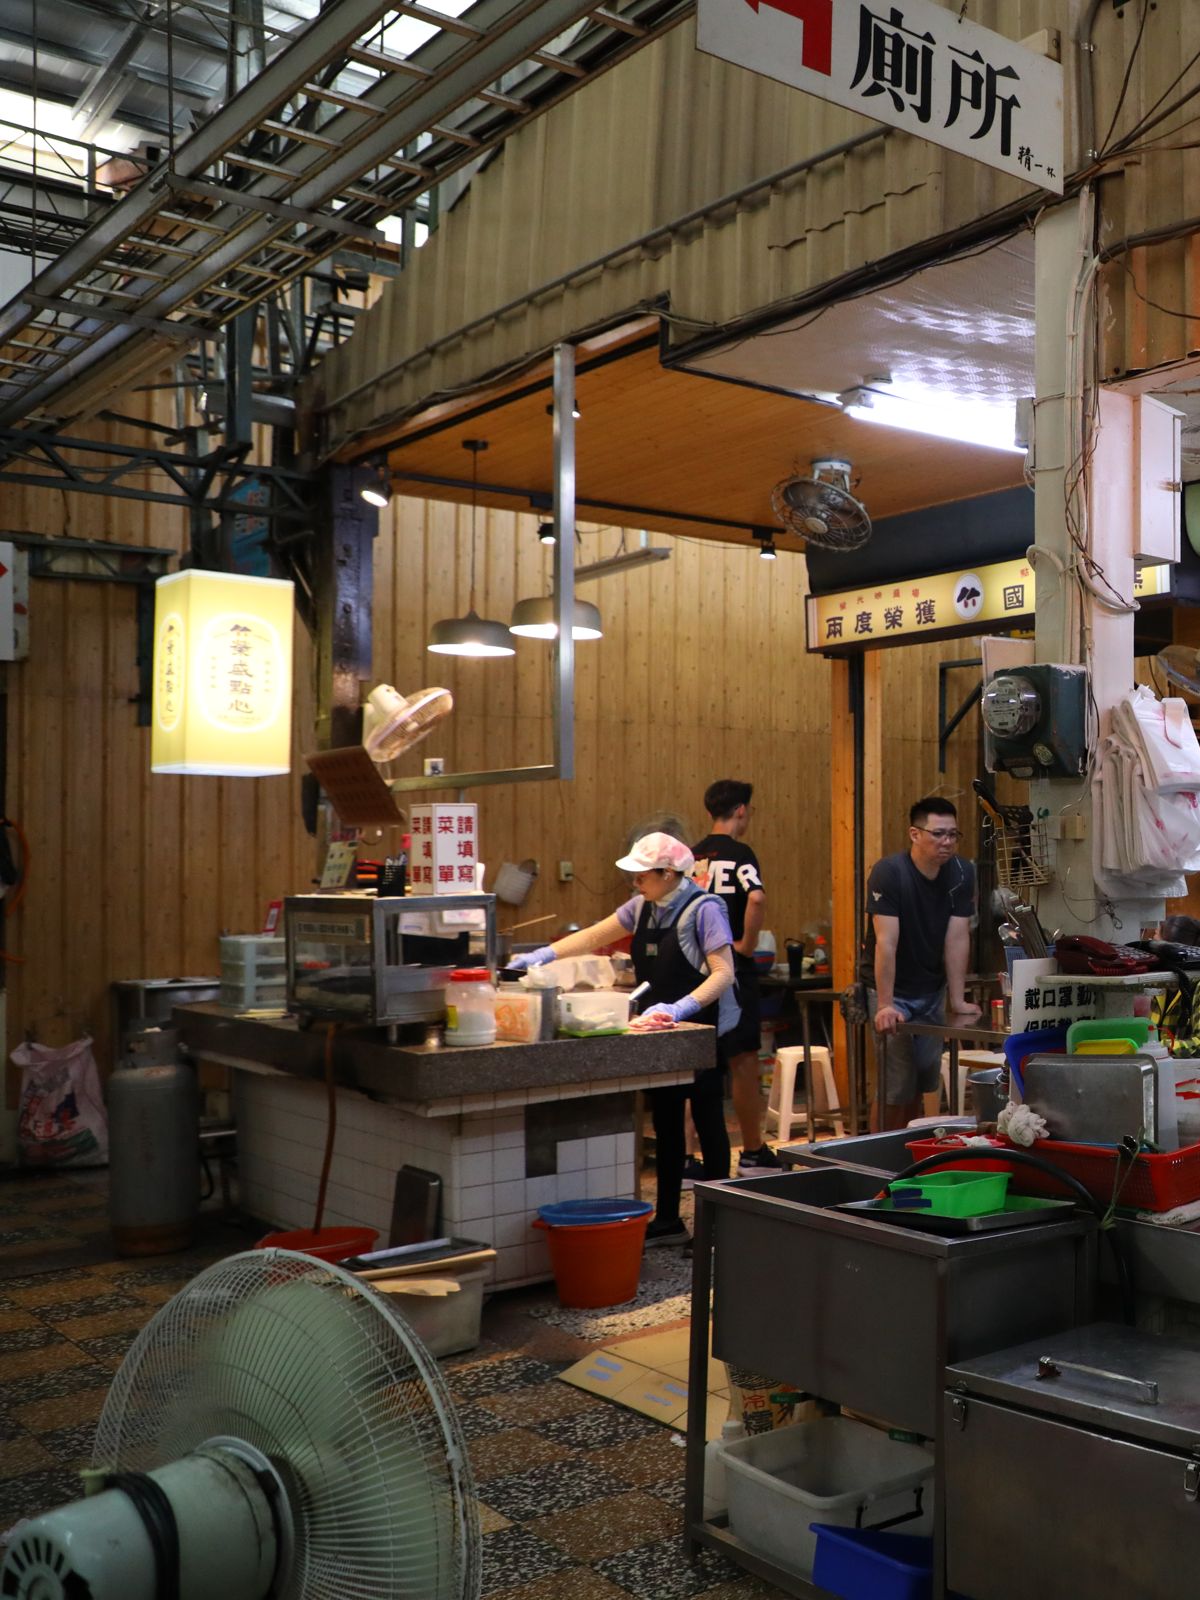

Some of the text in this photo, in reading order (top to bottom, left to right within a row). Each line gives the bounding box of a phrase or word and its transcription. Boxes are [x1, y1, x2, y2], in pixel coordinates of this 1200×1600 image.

[850, 3, 1021, 157] 廁所
[826, 599, 936, 639] 兩度榮獲
[1003, 584, 1025, 611] 國
[438, 816, 454, 883] 菜單
[457, 816, 474, 882] 請填寫
[1025, 985, 1096, 1010] 戴口罩勤
